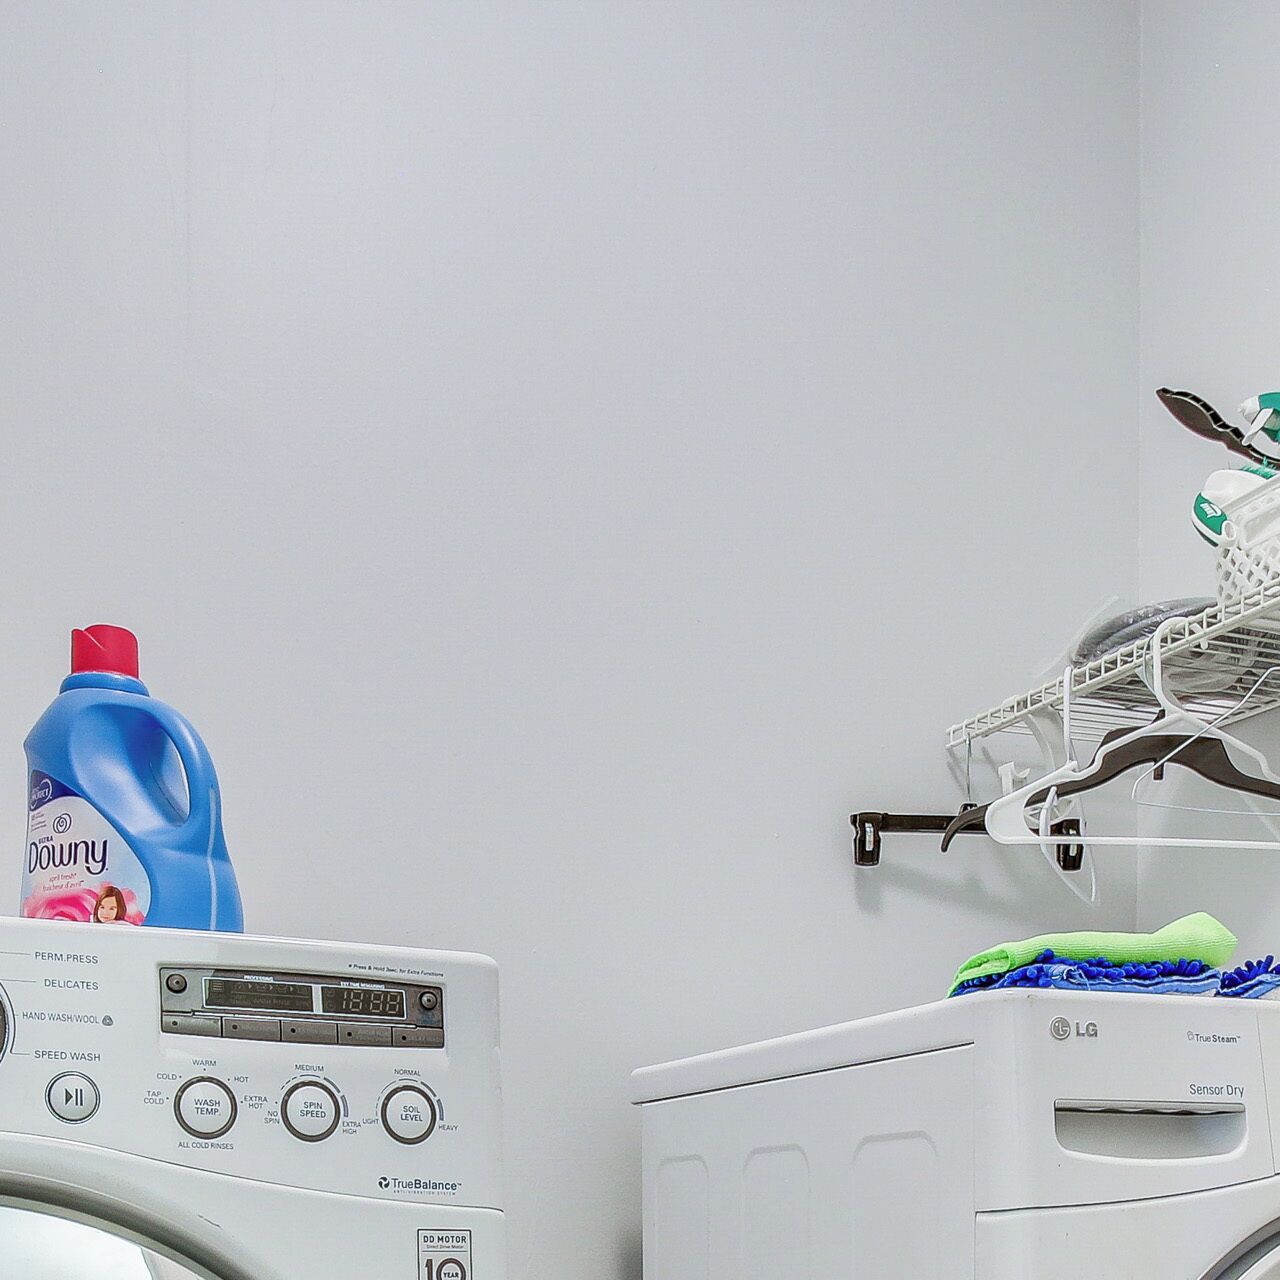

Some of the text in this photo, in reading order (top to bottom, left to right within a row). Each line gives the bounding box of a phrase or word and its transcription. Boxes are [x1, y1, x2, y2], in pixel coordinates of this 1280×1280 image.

[28, 839, 108, 876] Downy
[44, 978, 99, 991] DELICATES
[22, 1011, 100, 1024] HAND WASH/WOOL
[1075, 1021, 1099, 1038] LG
[34, 1049, 101, 1062] SPEED WASH
[192, 1059, 217, 1067] WARM
[295, 1064, 325, 1072] MEDIUM
[394, 1068, 421, 1077] NORMAL
[1189, 1083, 1245, 1099] Sensor Dry
[143, 1097, 165, 1105] COLD
[194, 1098, 221, 1107] WASH
[244, 1095, 268, 1103] EXTRA
[303, 1101, 324, 1110] SPIN
[402, 1105, 421, 1114] SOIL
[299, 1109, 327, 1119] SPEED
[400, 1113, 423, 1122] LEVEL
[264, 1117, 280, 1125] SPIN
[342, 1128, 358, 1136] HIGH
[438, 1124, 459, 1132] HEAVY
[178, 1141, 191, 1149] ALL
[210, 1142, 234, 1150] RINSES
[423, 1235, 467, 1243] DD MOTOR
[443, 1271, 459, 1279] YEAR
